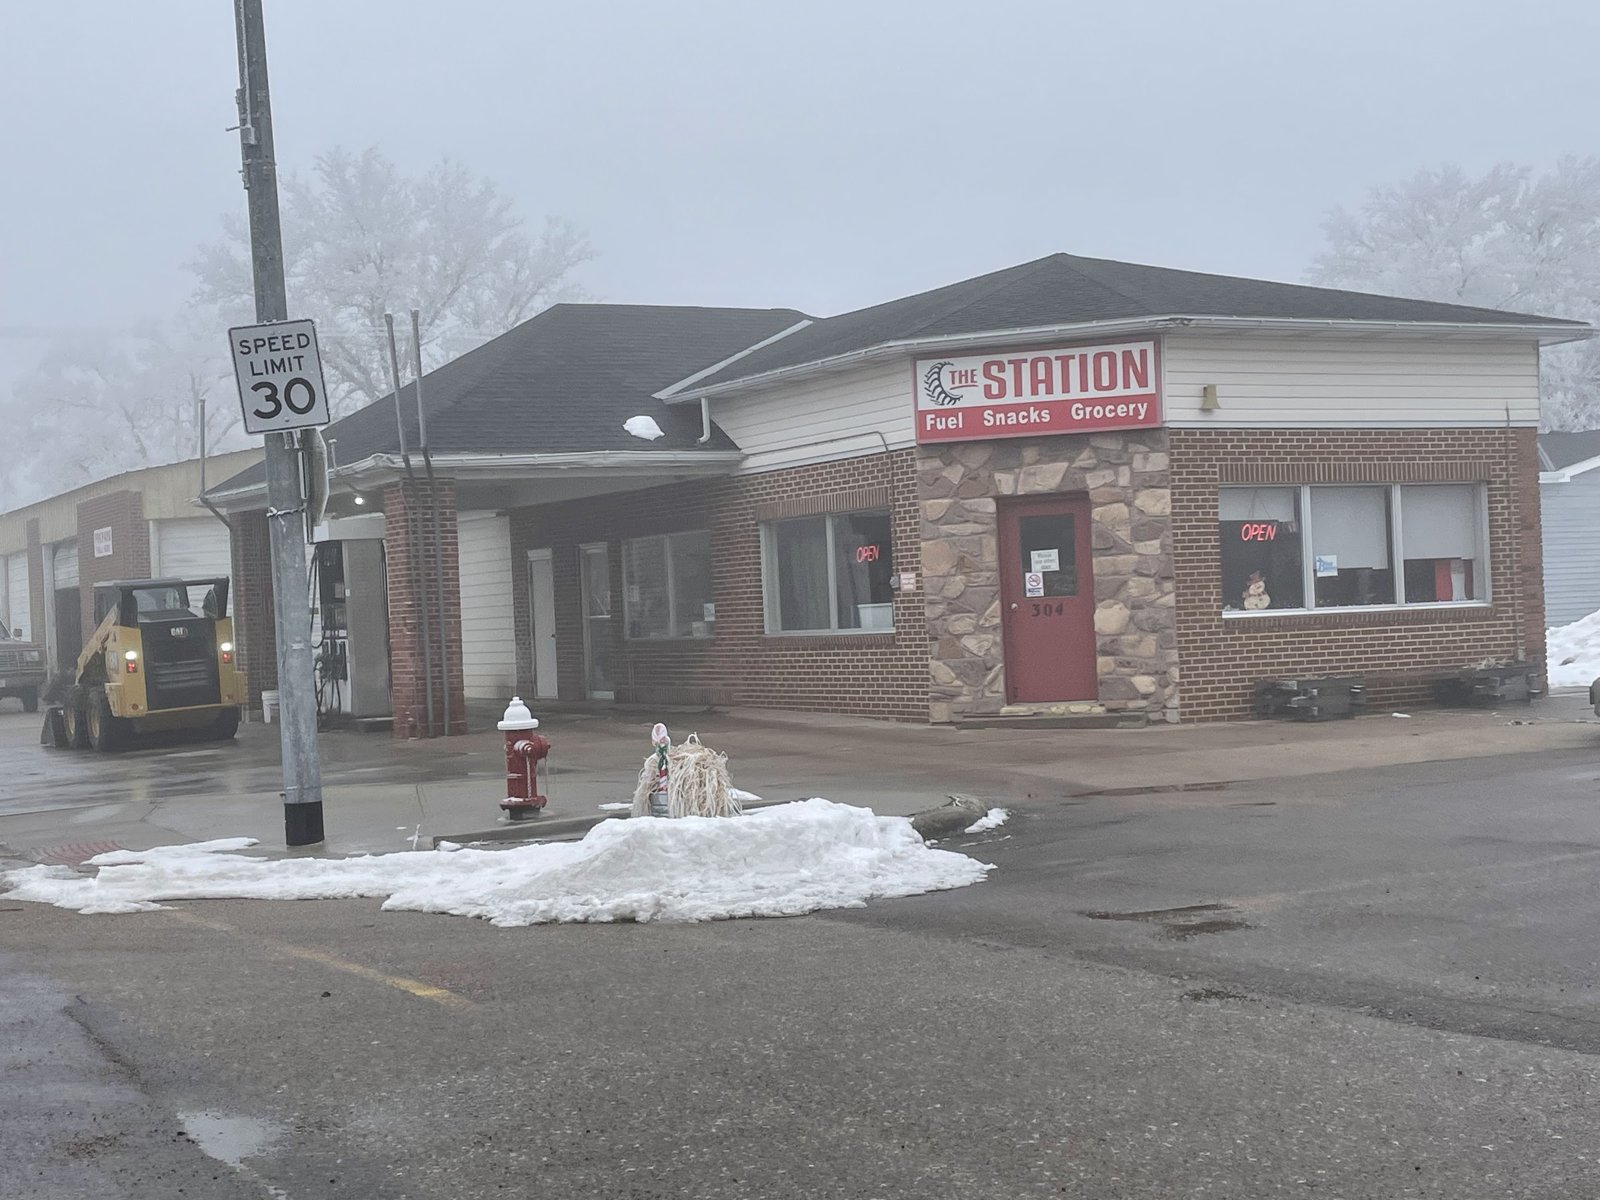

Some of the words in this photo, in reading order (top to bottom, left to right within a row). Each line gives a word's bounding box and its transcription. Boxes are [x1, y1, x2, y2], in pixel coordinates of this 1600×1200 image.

[239, 333, 310, 355] SPEED
[250, 355, 304, 376] LIMIT
[949, 368, 978, 385] THE
[983, 348, 1149, 399] STATION
[251, 377, 316, 419] 30
[926, 412, 963, 431] Fuel
[983, 406, 1050, 427] Snacks
[1071, 402, 1148, 420] Grocery
[1241, 523, 1277, 542] OPEN
[856, 545, 879, 563] OPEN
[1031, 603, 1064, 617] 304
[170, 627, 183, 636] CAT
